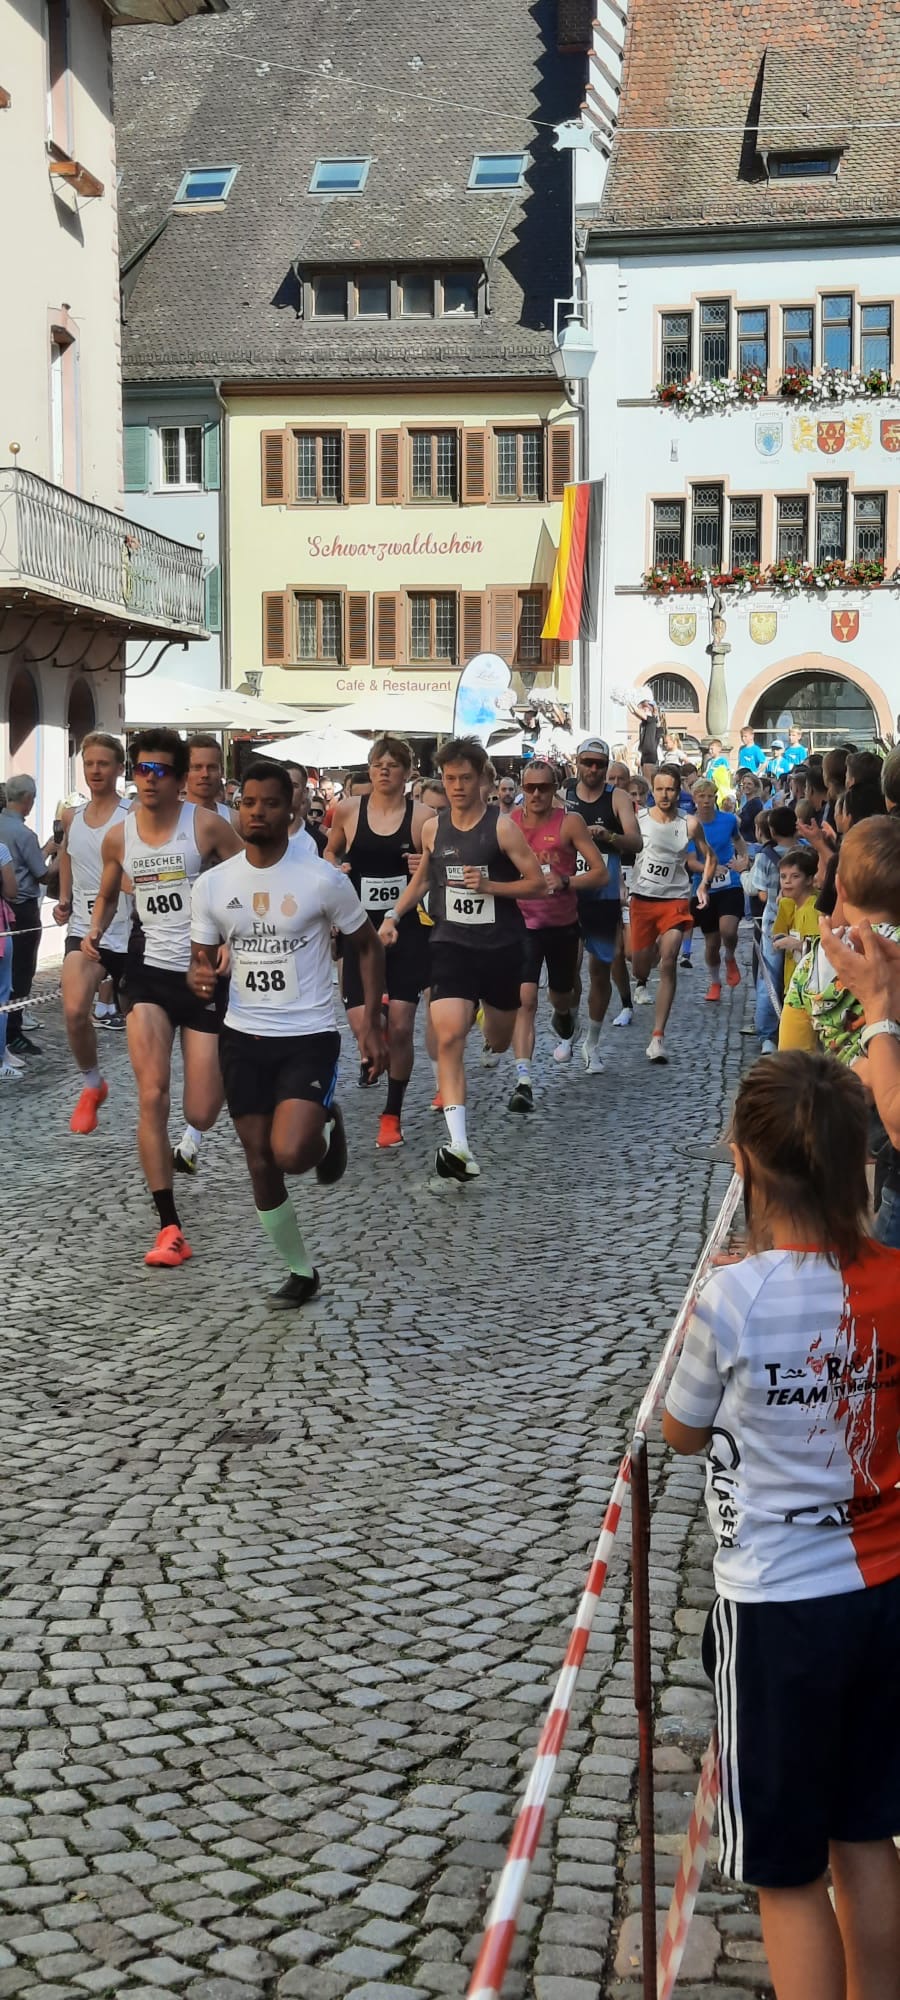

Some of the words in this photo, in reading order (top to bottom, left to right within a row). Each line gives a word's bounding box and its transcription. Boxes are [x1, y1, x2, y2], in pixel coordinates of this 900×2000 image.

[307, 532, 484, 561] Schwarzwaldschön
[336, 679, 365, 691] Café
[369, 680, 378, 691] &
[382, 679, 452, 692] Restaurant
[133, 855, 182, 868] DRESCHER
[647, 863, 670, 877] 320
[369, 886, 400, 901] 269
[147, 892, 183, 914] 480
[453, 898, 485, 915] 487
[253, 922, 276, 936] Fly
[230, 935, 308, 954] Emirates
[245, 969, 286, 992] 438
[766, 1385, 828, 1406] TEAM
